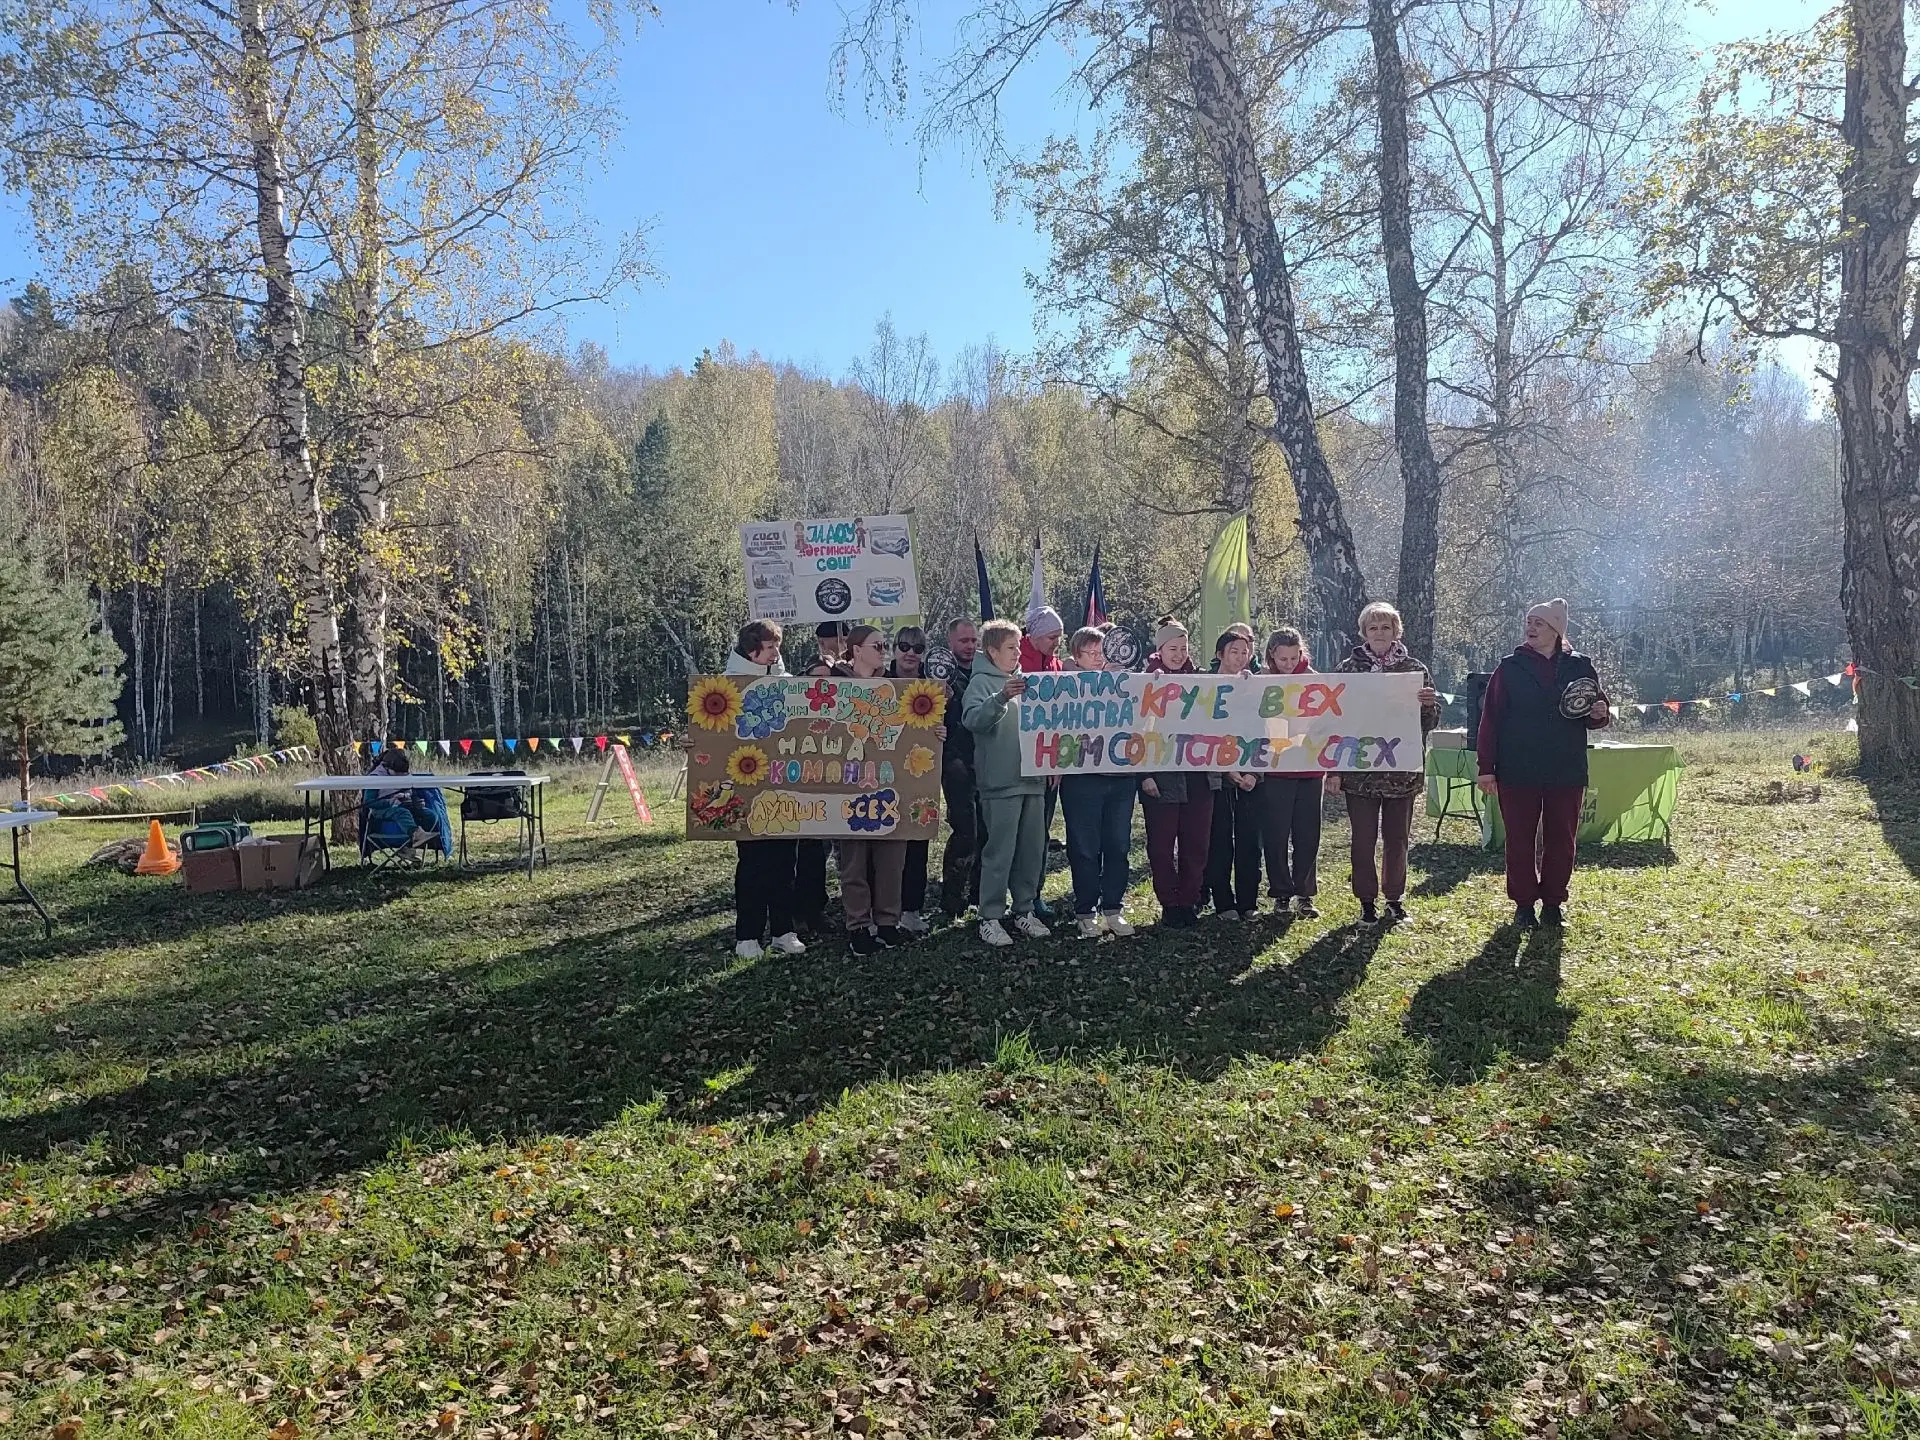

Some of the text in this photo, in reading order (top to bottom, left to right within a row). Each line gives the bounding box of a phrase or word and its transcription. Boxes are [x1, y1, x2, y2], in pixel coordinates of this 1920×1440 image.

[1140, 682, 1346, 720] КРУЧЕ ВСЕХ
[778, 735, 866, 761] НАША
[1035, 731, 1401, 770] НАМ СОПУТСТВУЕТ УСПЕХ
[769, 758, 896, 790] КОМАНДА
[751, 798, 900, 822] ЛУЧШЕ ВСЕХ
